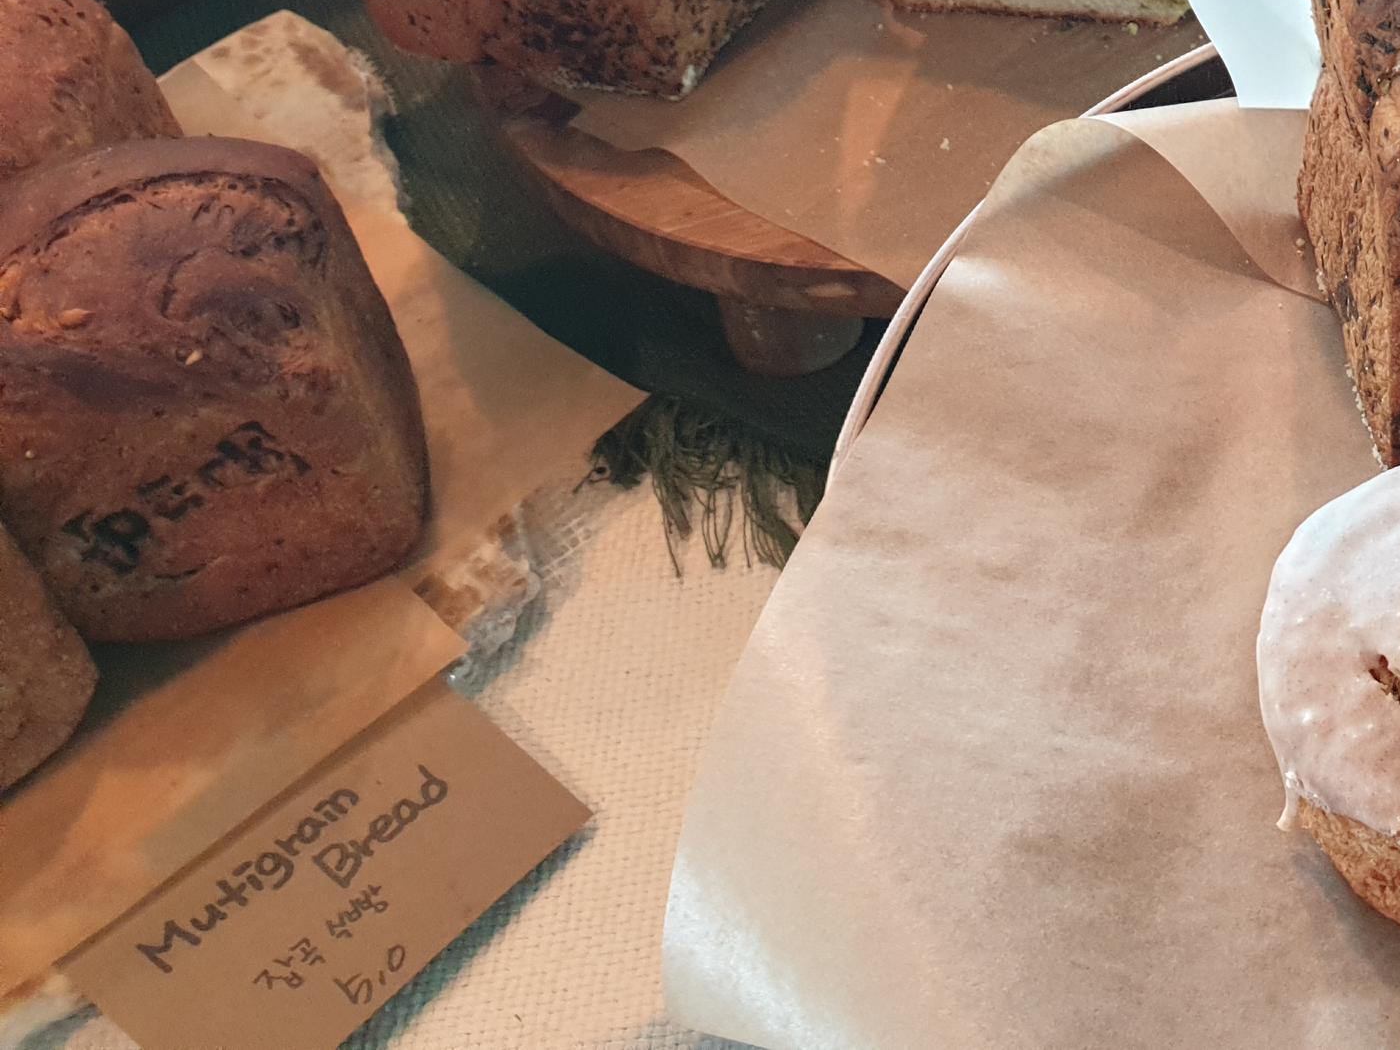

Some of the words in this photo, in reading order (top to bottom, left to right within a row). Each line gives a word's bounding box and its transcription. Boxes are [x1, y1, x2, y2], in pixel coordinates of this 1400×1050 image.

[135, 787, 360, 974] Mutigrain
[311, 764, 450, 888] Bread
[252, 936, 326, 991] 잡곡
[325, 883, 391, 939] 식빵
